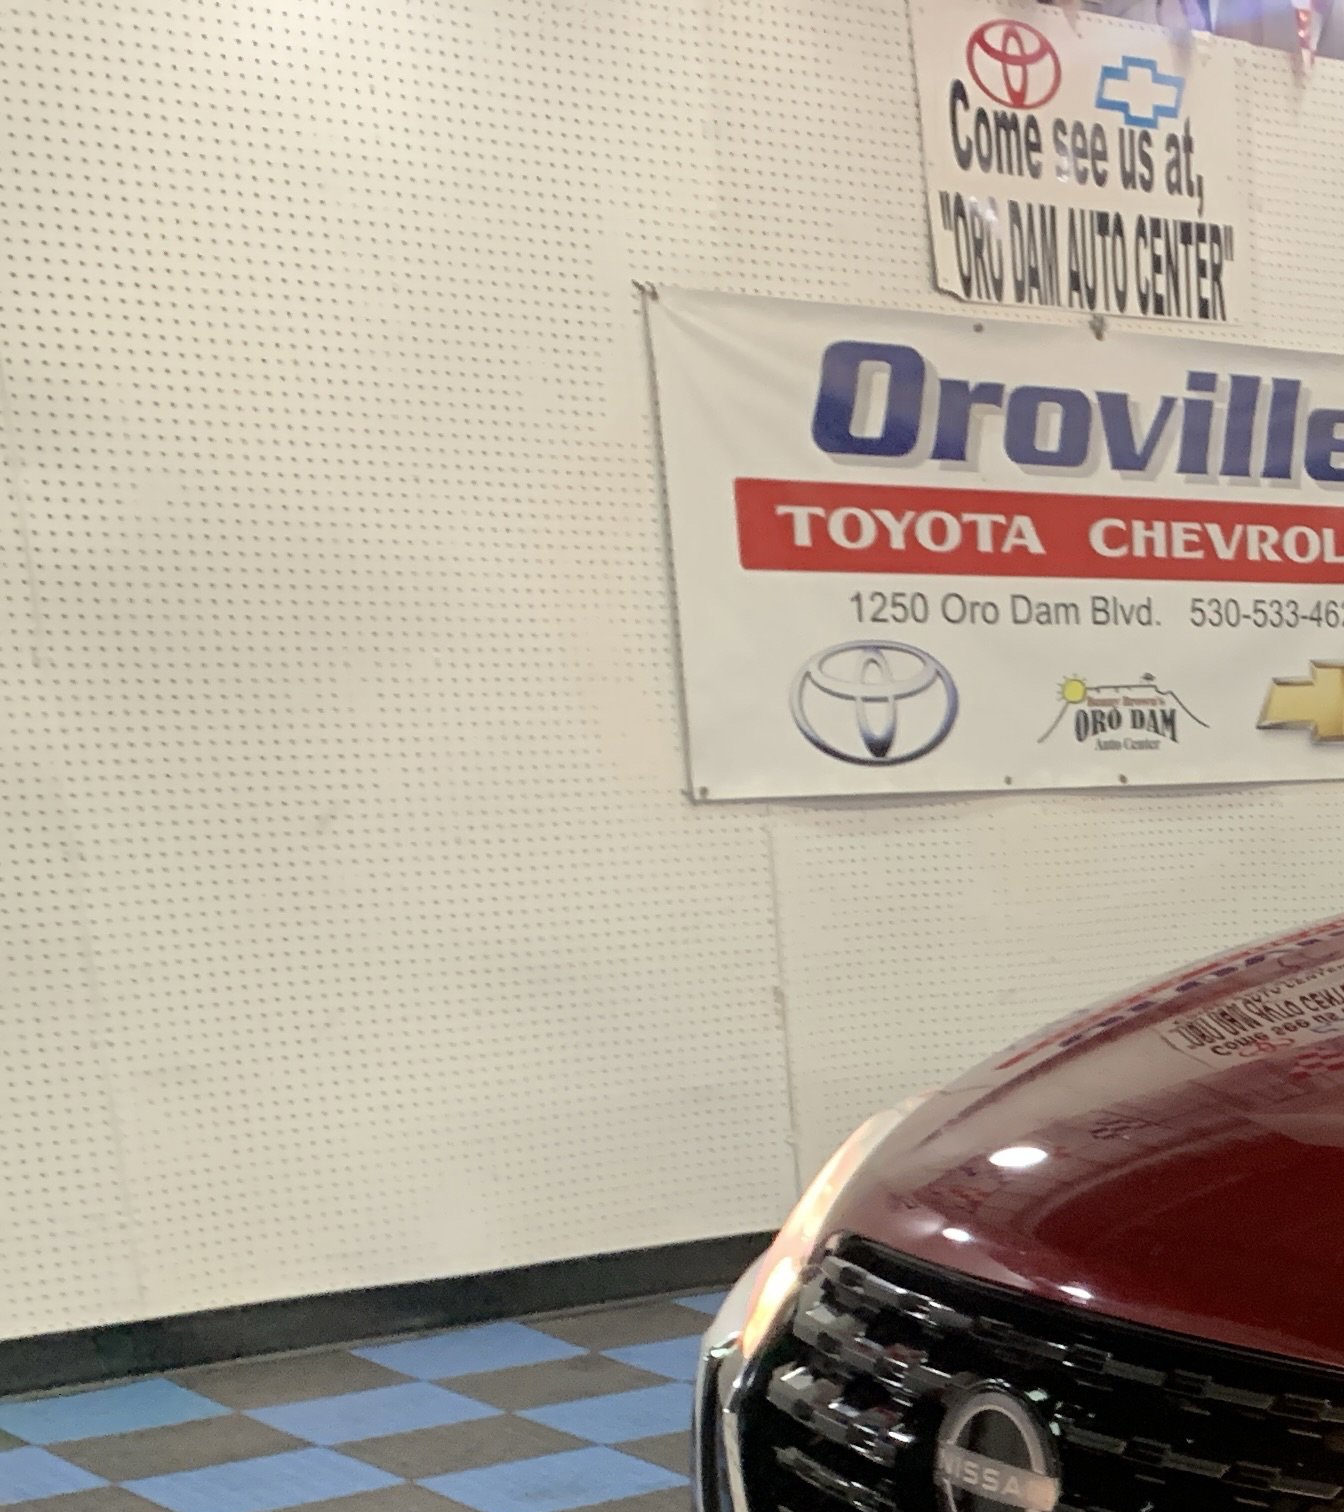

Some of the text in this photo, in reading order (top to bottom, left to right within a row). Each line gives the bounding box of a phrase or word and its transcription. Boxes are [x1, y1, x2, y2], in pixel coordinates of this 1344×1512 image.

[950, 79, 1204, 218] Come see us at,
[1008, 199, 1061, 306] DAM
[1069, 207, 1127, 313] AUTO
[1136, 214, 1234, 321] CENTER"
[774, 504, 1046, 555] TOYOTA
[848, 590, 929, 624] 1250
[941, 592, 1000, 625] Oro
[1010, 594, 1080, 626] Dam
[1090, 596, 1161, 627] Blvd.
[1075, 707, 1179, 744] ORO DAM
